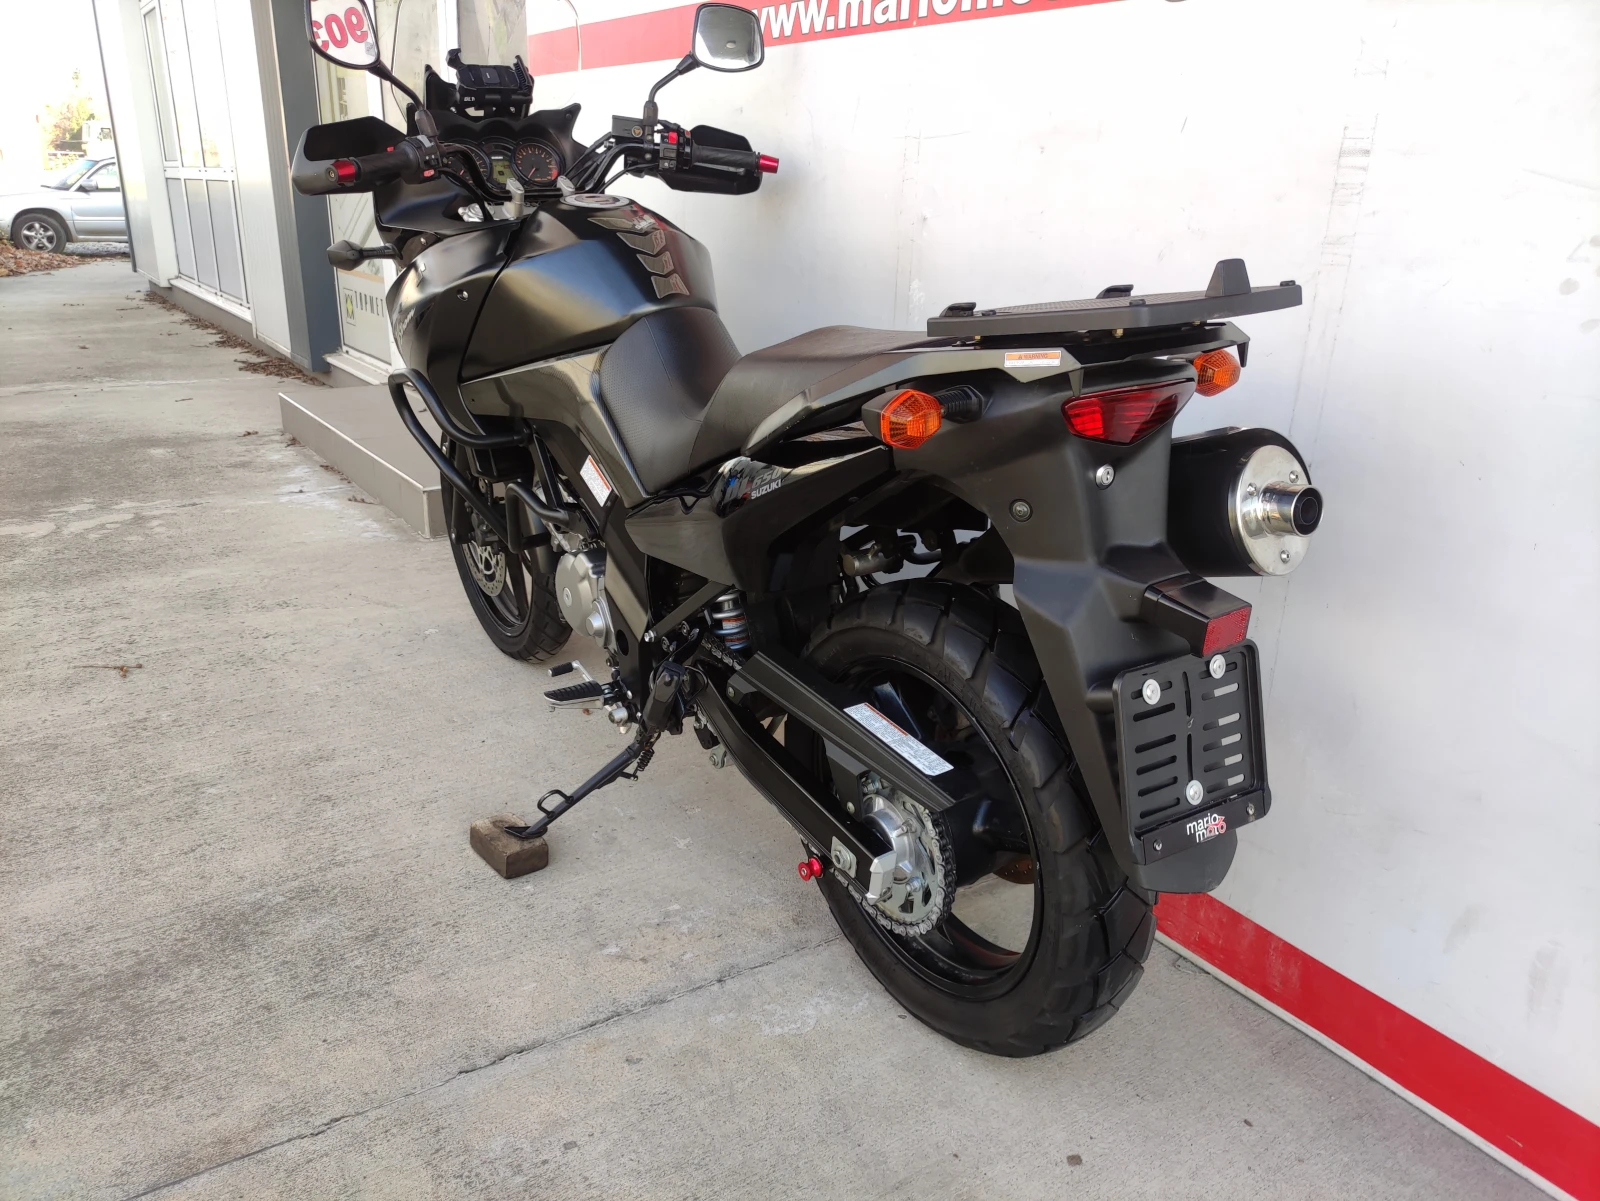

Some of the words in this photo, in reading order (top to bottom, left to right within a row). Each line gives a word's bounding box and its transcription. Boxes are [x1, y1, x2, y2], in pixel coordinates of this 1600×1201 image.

[751, 479, 781, 499] SUZUKI
[752, 468, 781, 489] 650
[1186, 812, 1219, 836] mario
